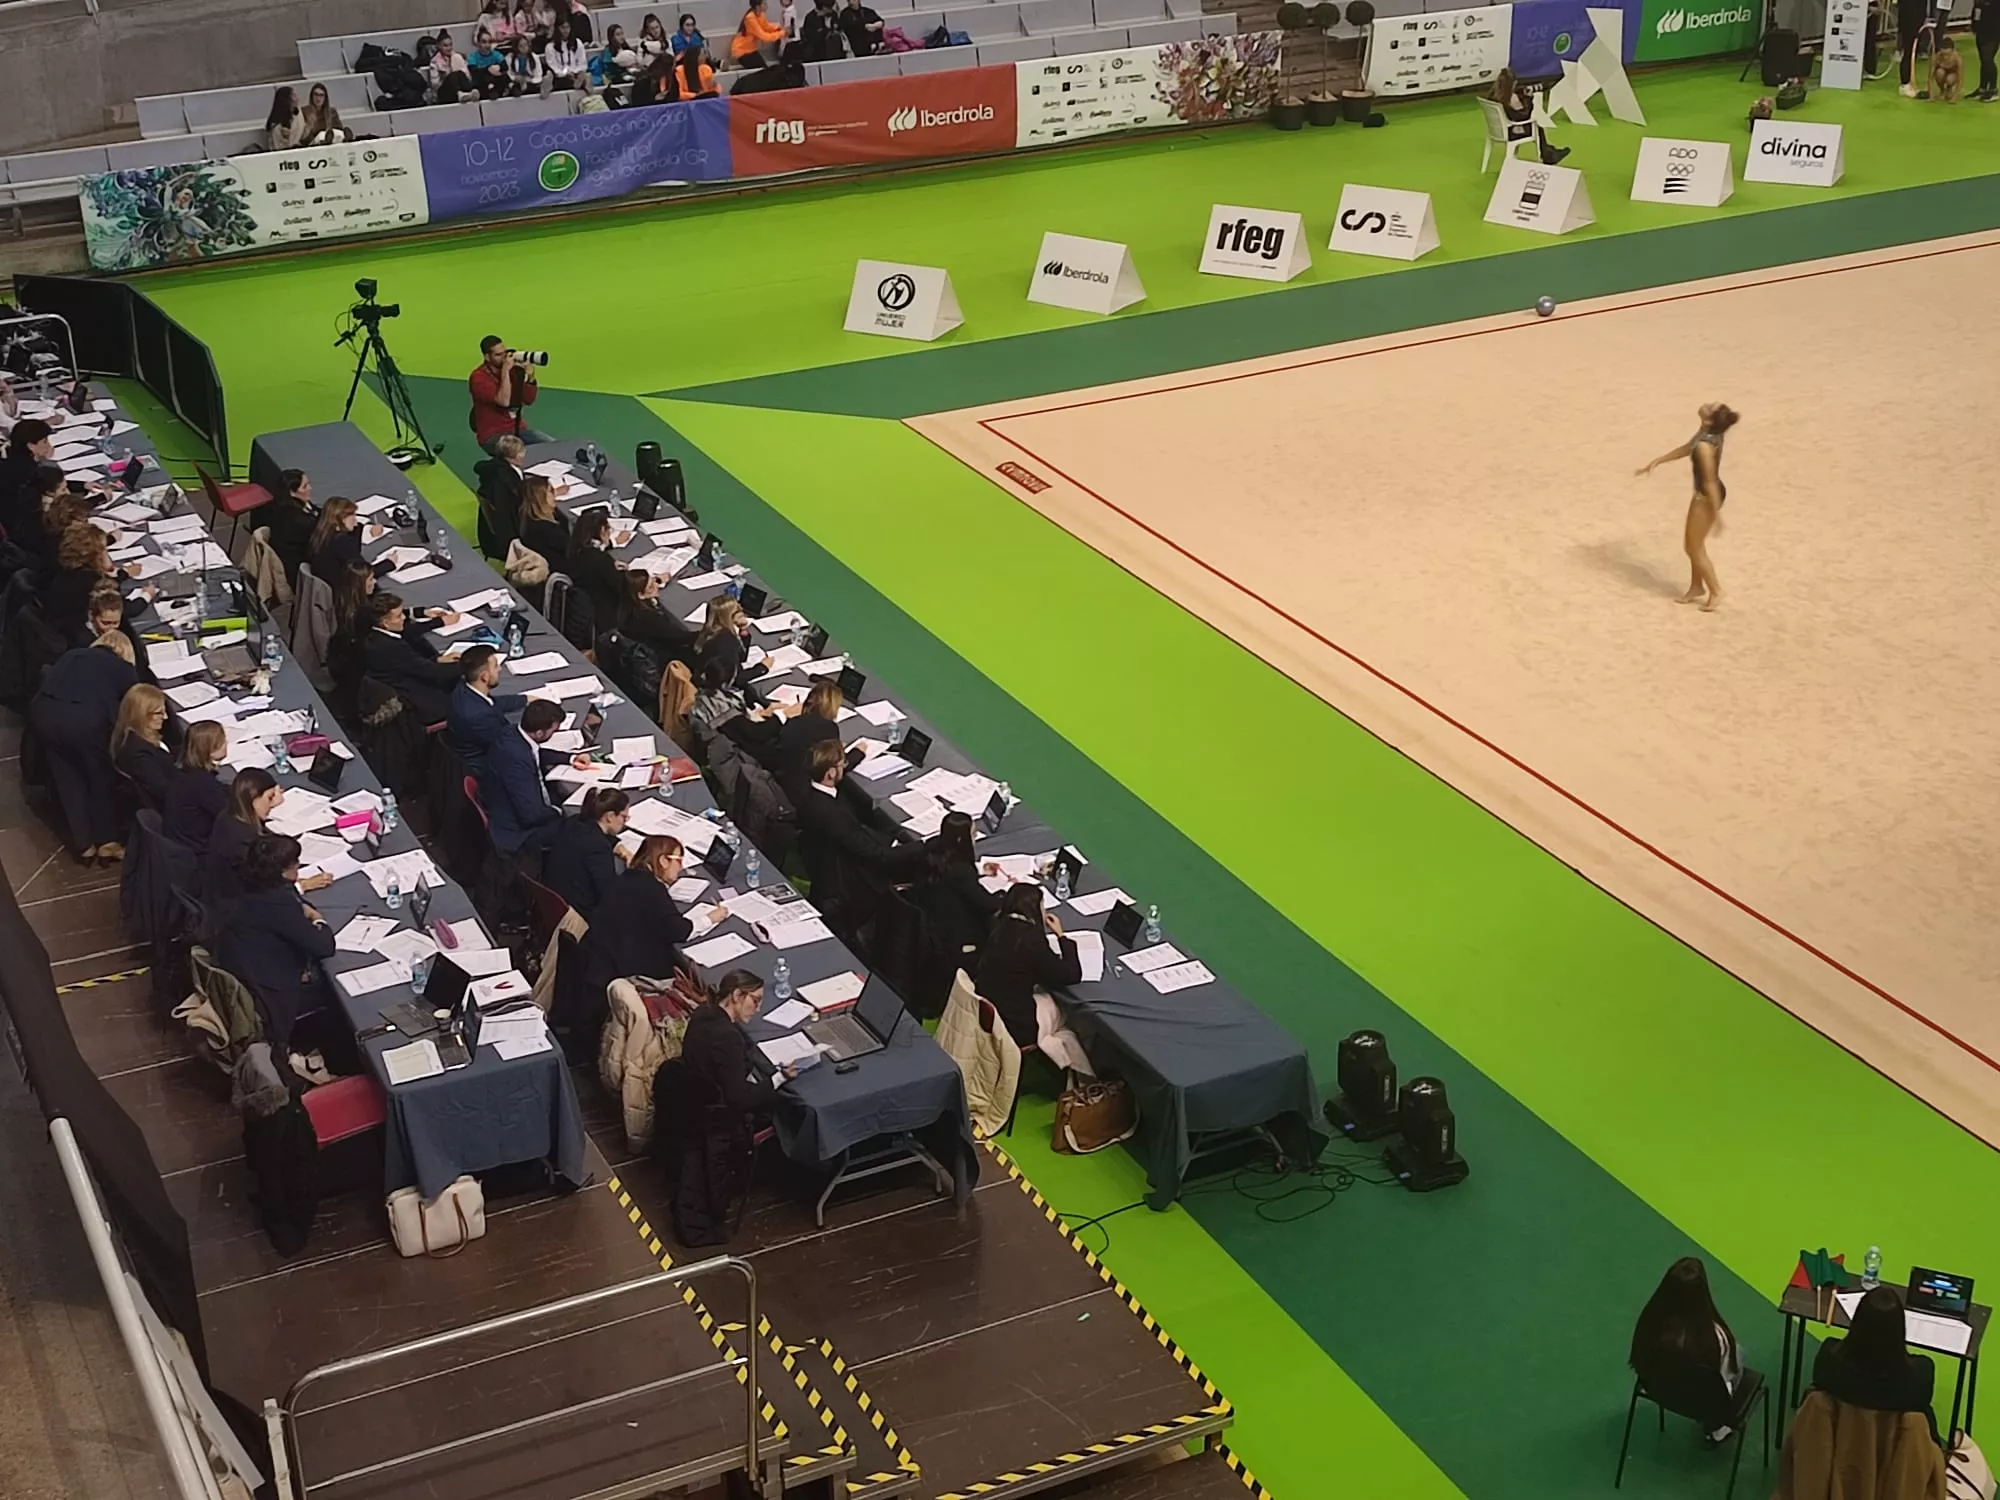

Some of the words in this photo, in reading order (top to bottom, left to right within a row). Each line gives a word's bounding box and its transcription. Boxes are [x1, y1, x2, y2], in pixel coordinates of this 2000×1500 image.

[1686, 5, 1751, 29] Iberdrola
[920, 104, 994, 127] Iberdrola
[529, 130, 578, 150] Copa
[582, 123, 622, 141] Base
[756, 118, 805, 145] rfeg
[463, 136, 516, 167] 10-12
[685, 149, 708, 166] GR
[1761, 137, 1827, 159] divina
[479, 180, 521, 204] 2023
[1216, 218, 1285, 260] rfeg
[1064, 265, 1109, 284] Iberdrola
